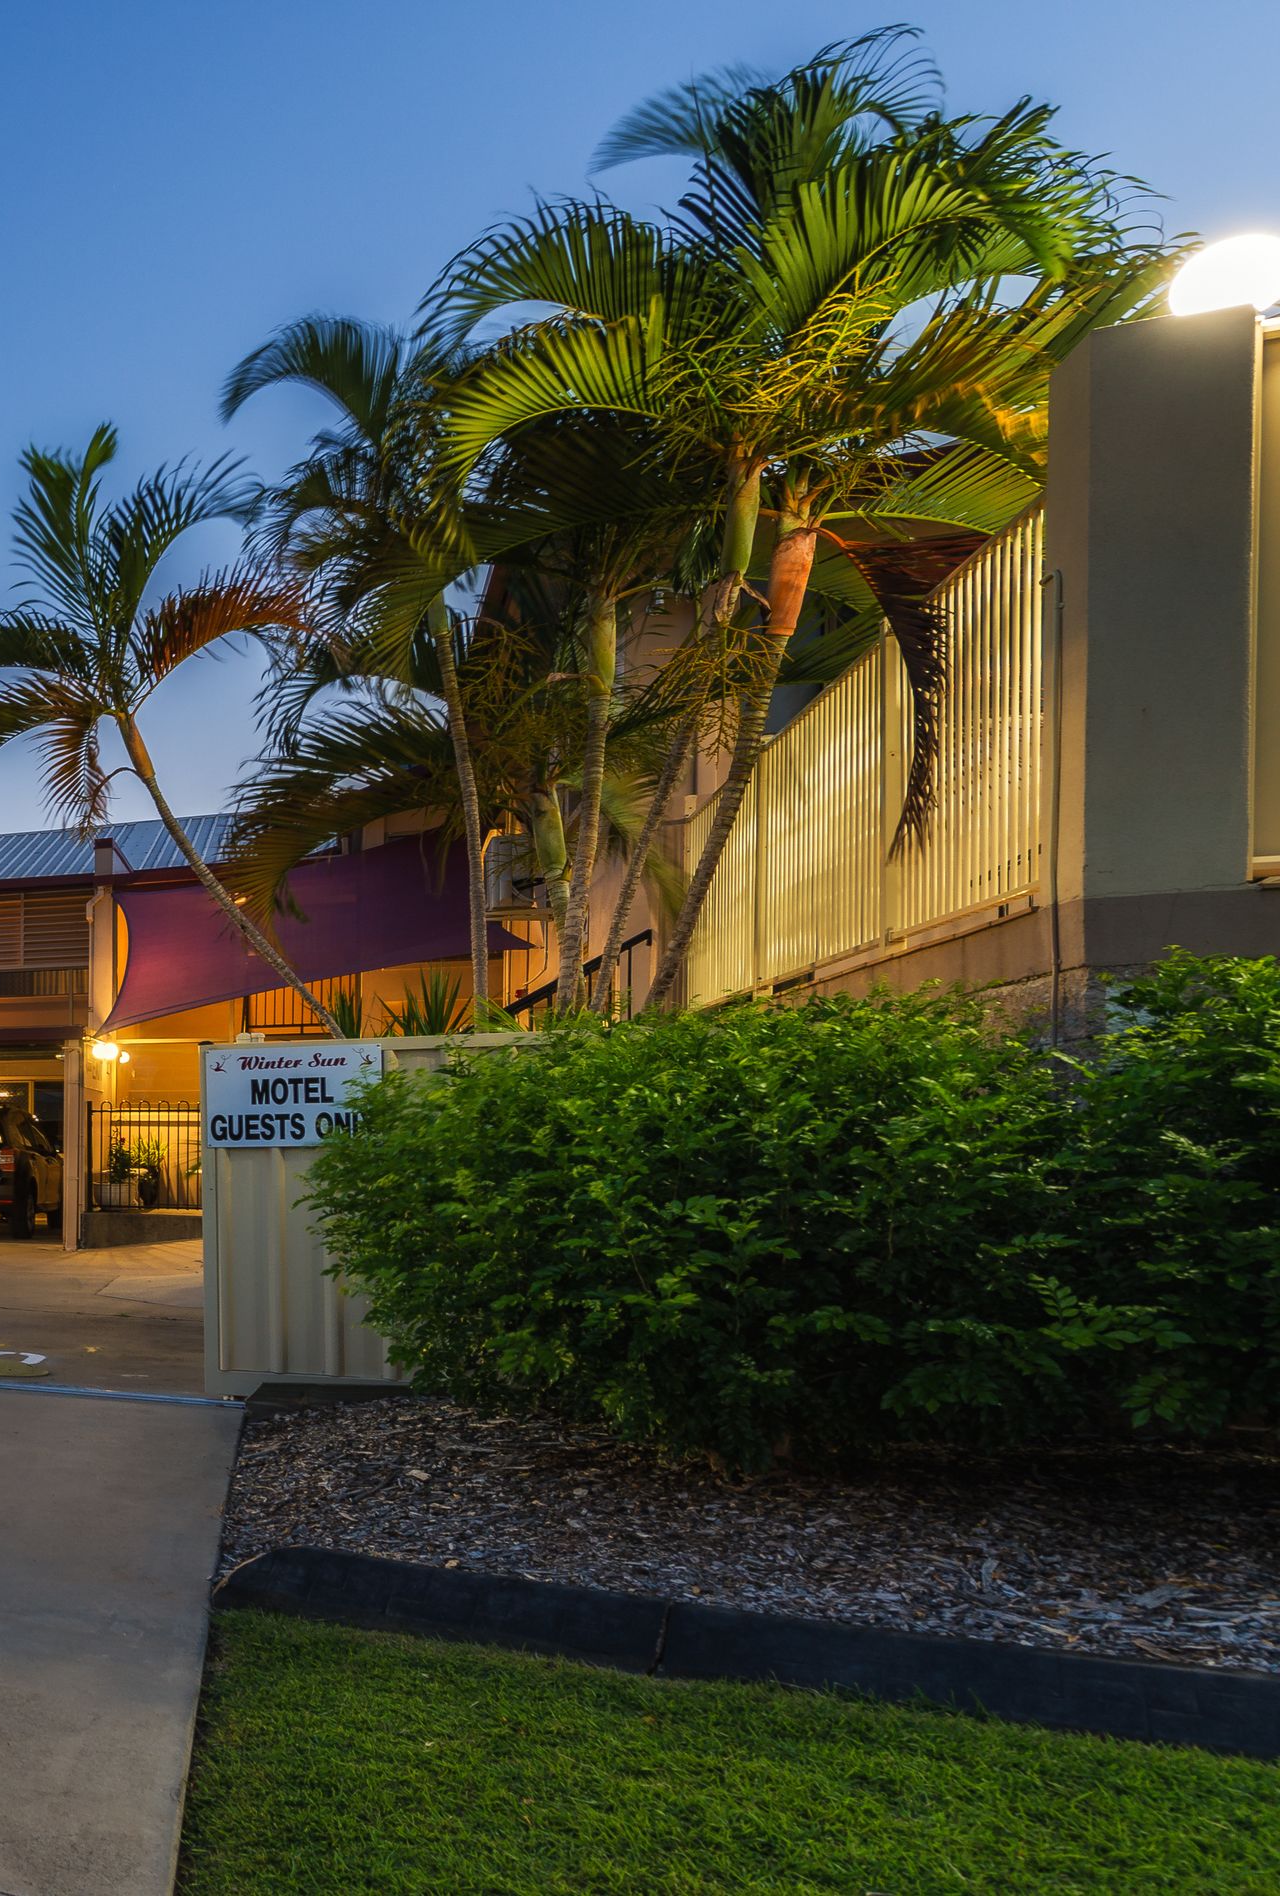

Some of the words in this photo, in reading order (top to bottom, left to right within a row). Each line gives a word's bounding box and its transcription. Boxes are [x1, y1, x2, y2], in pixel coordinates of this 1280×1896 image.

[237, 1055, 303, 1071] Winter
[308, 1052, 348, 1068] Sun
[250, 1077, 334, 1105] MOTEL
[210, 1112, 305, 1141] GUESTS
[315, 1111, 365, 1140] ONL
